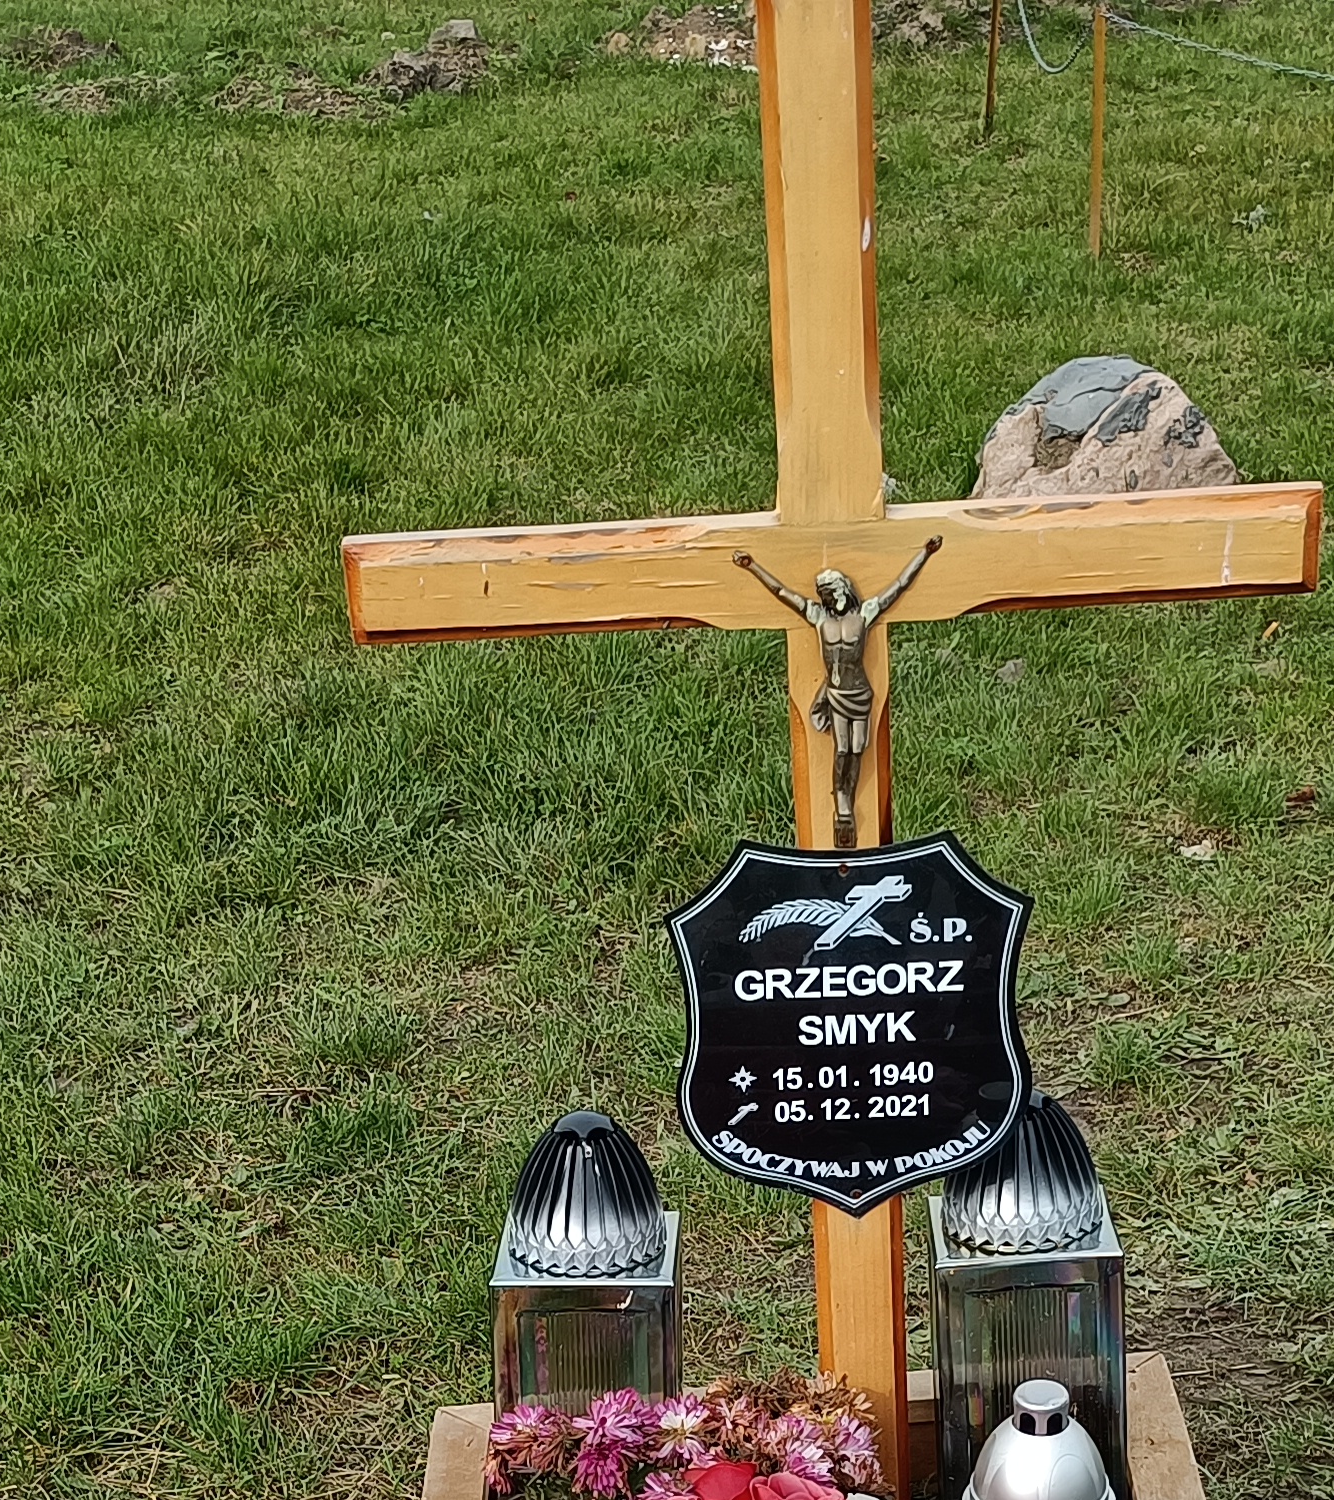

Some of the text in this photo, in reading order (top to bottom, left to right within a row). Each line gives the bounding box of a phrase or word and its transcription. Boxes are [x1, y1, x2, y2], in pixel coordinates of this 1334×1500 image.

[909, 912, 973, 943] Ś.P.
[733, 960, 965, 1002] GRZEGORZ
[798, 1011, 916, 1046] SMYK
[712, 1120, 991, 1178] SPOCZYWAJ W POKOJU
